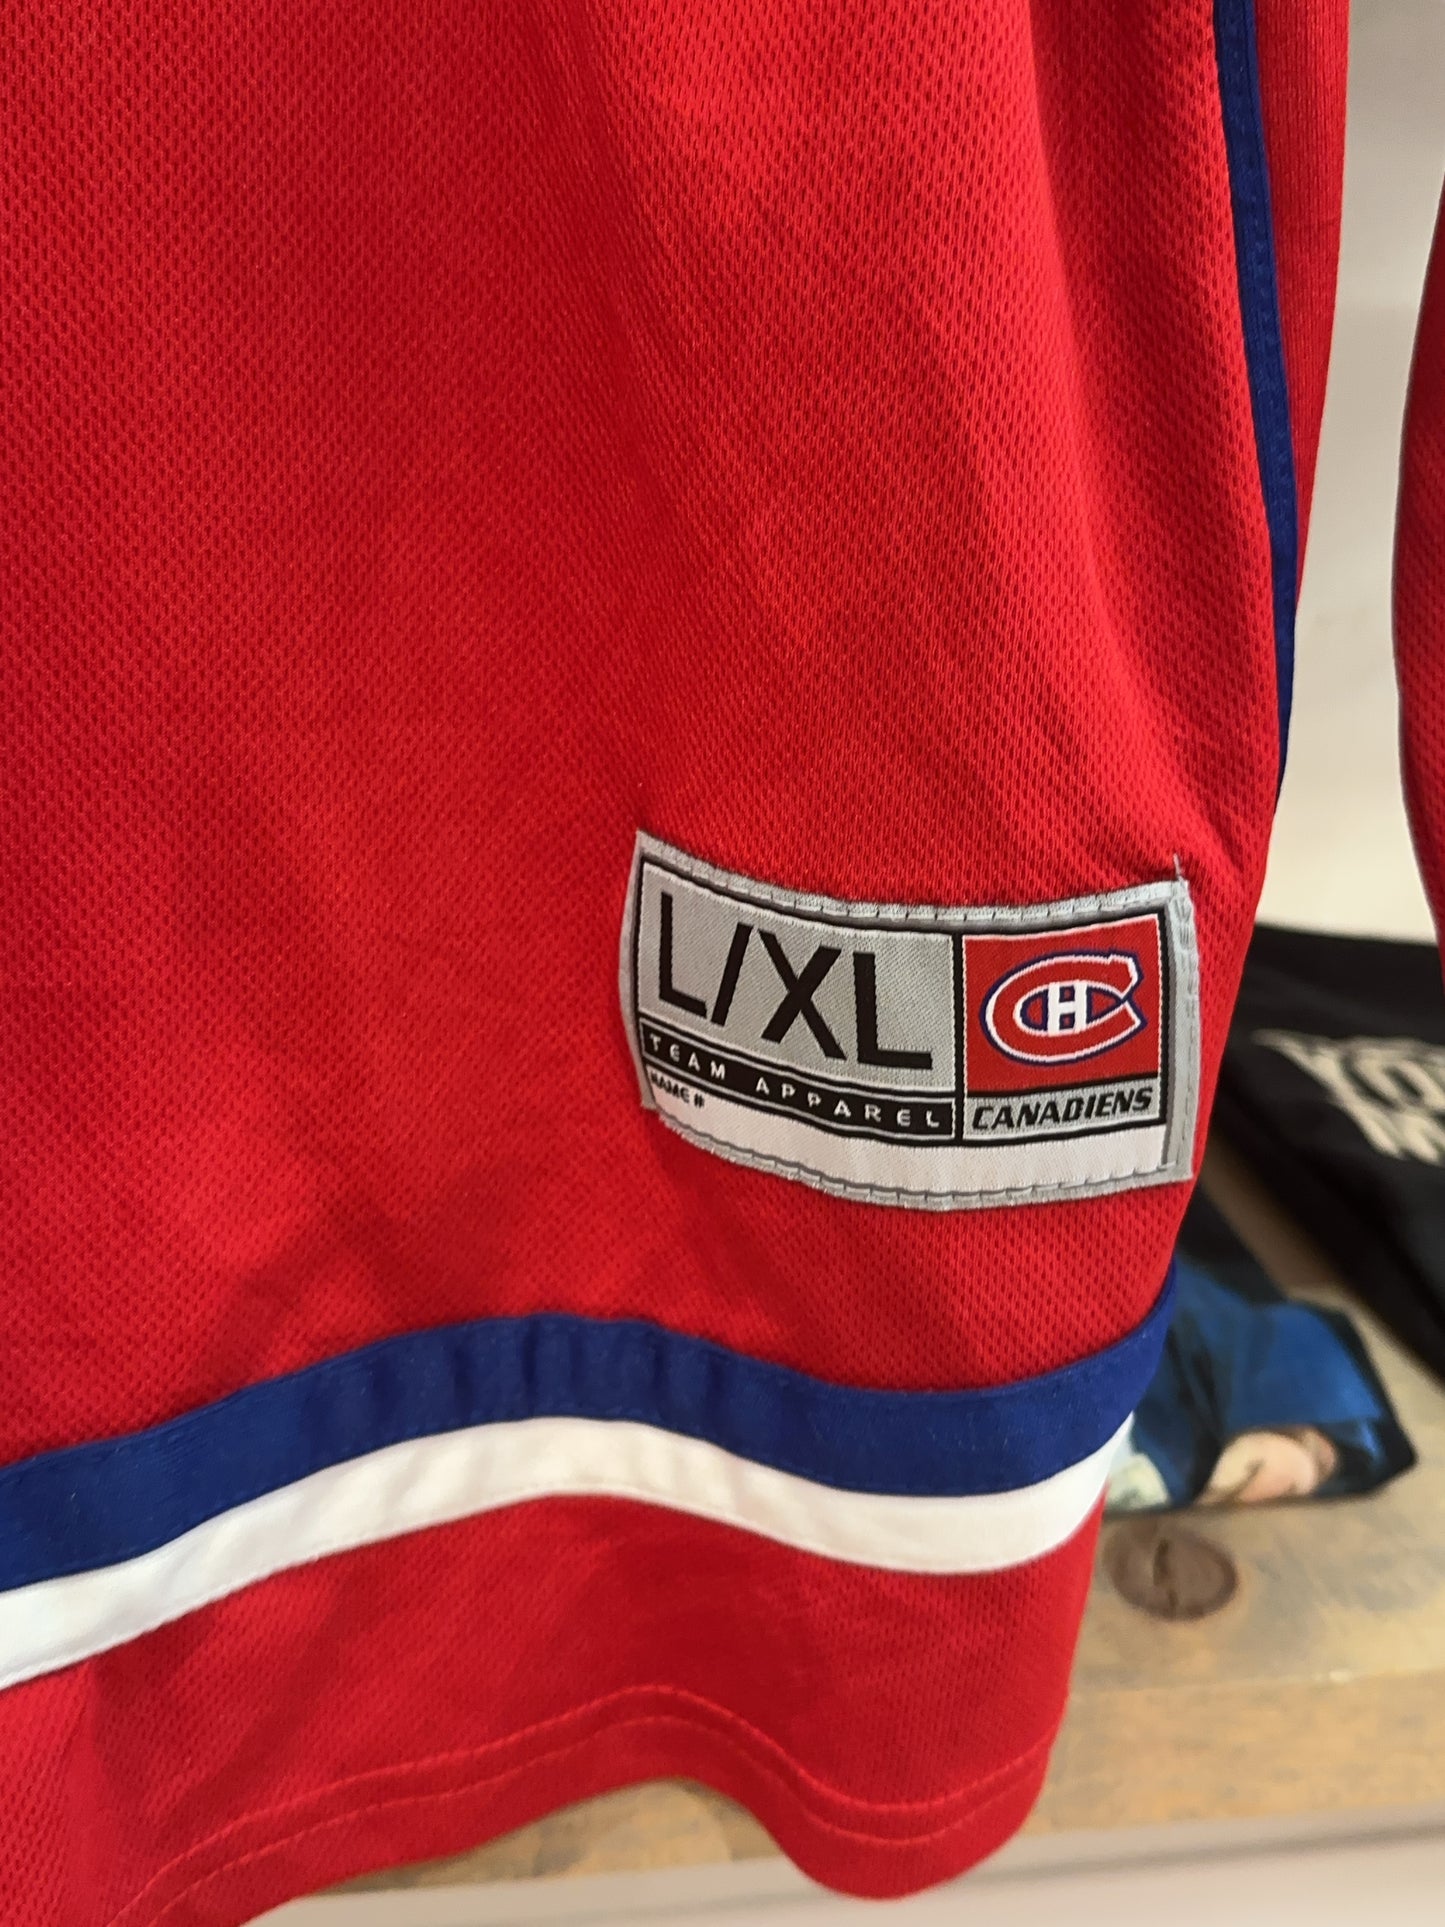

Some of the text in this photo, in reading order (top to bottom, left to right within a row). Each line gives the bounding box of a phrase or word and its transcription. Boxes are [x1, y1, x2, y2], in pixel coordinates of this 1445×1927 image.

[659, 891, 933, 1071] L/XL
[649, 1033, 940, 1128] TEAM APPAREL
[971, 1086, 1154, 1130] CANADIENS
